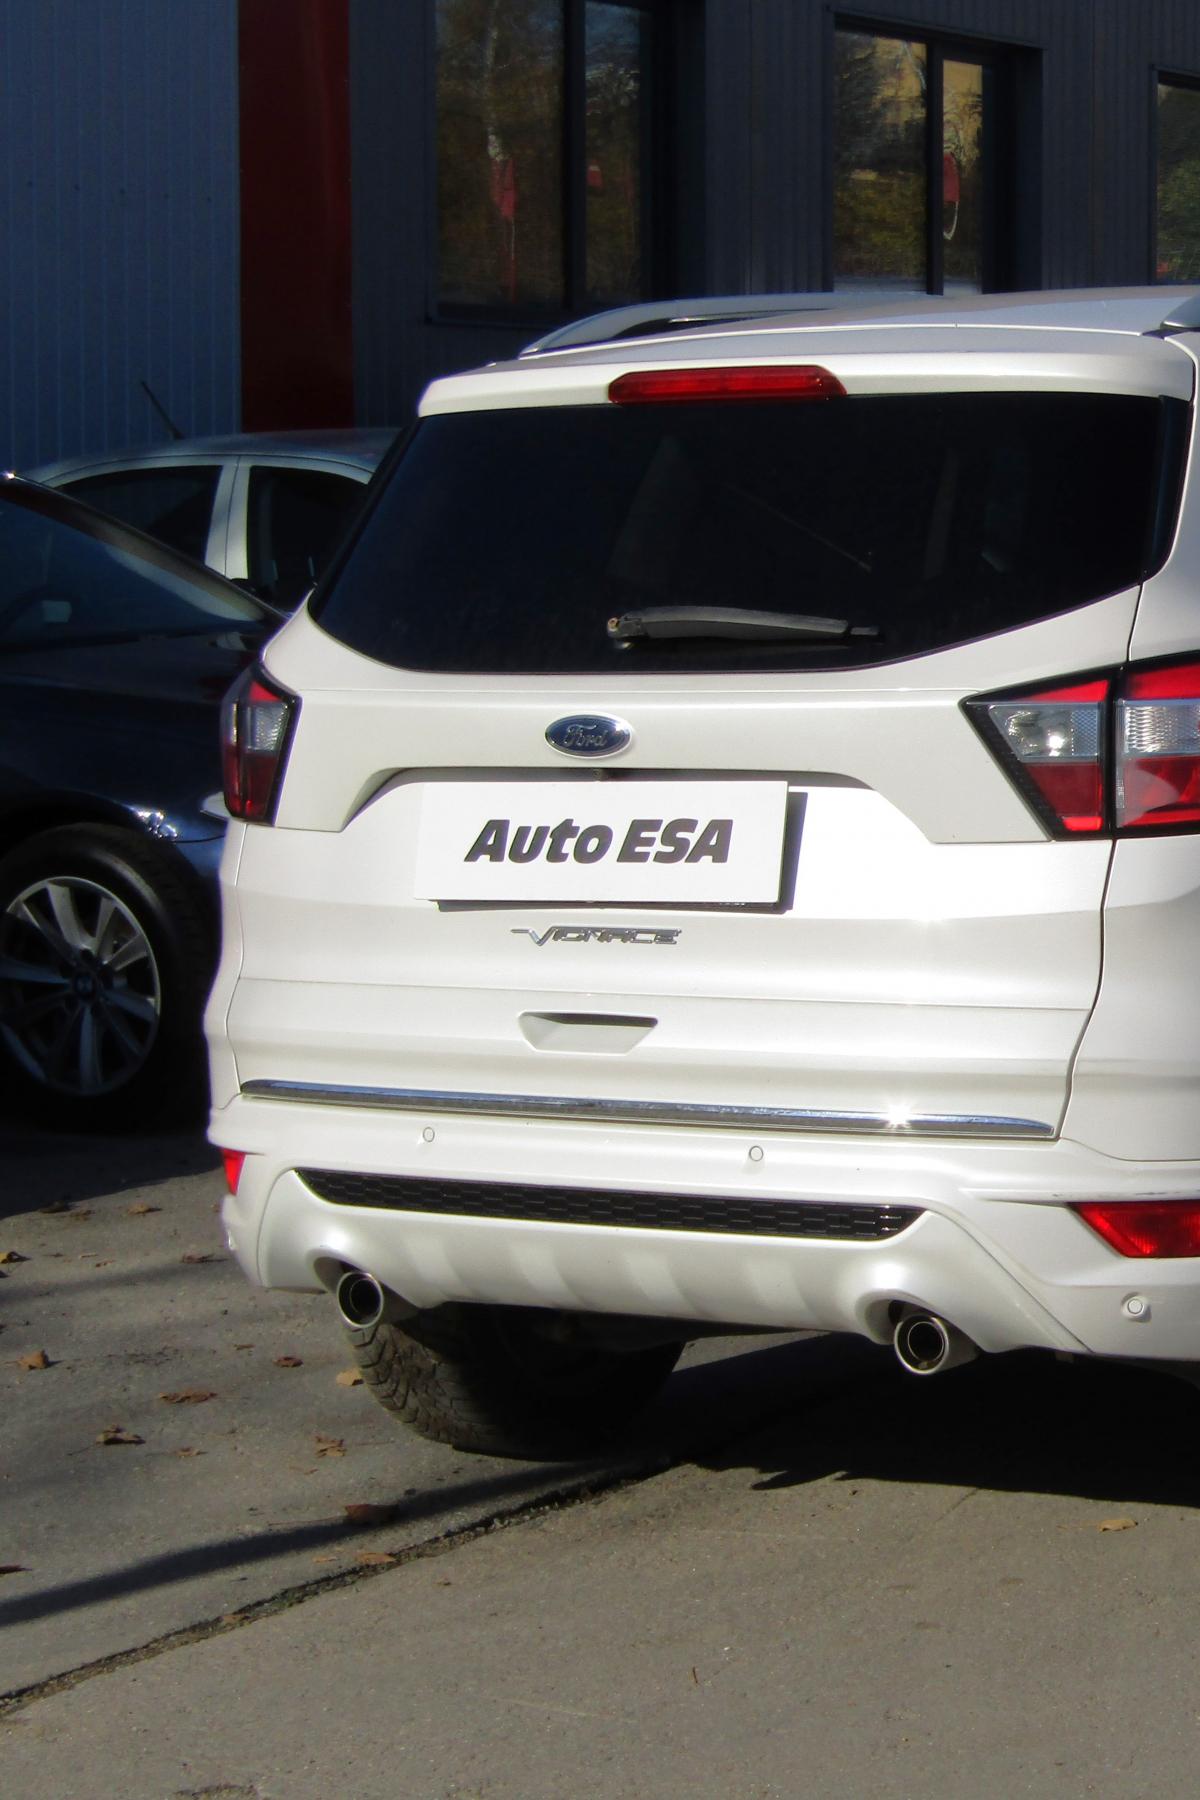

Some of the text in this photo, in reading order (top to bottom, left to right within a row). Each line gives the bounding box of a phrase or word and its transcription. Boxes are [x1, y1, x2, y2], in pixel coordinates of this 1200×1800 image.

[562, 723, 609, 748] Ford
[464, 818, 733, 864] Auto ESA
